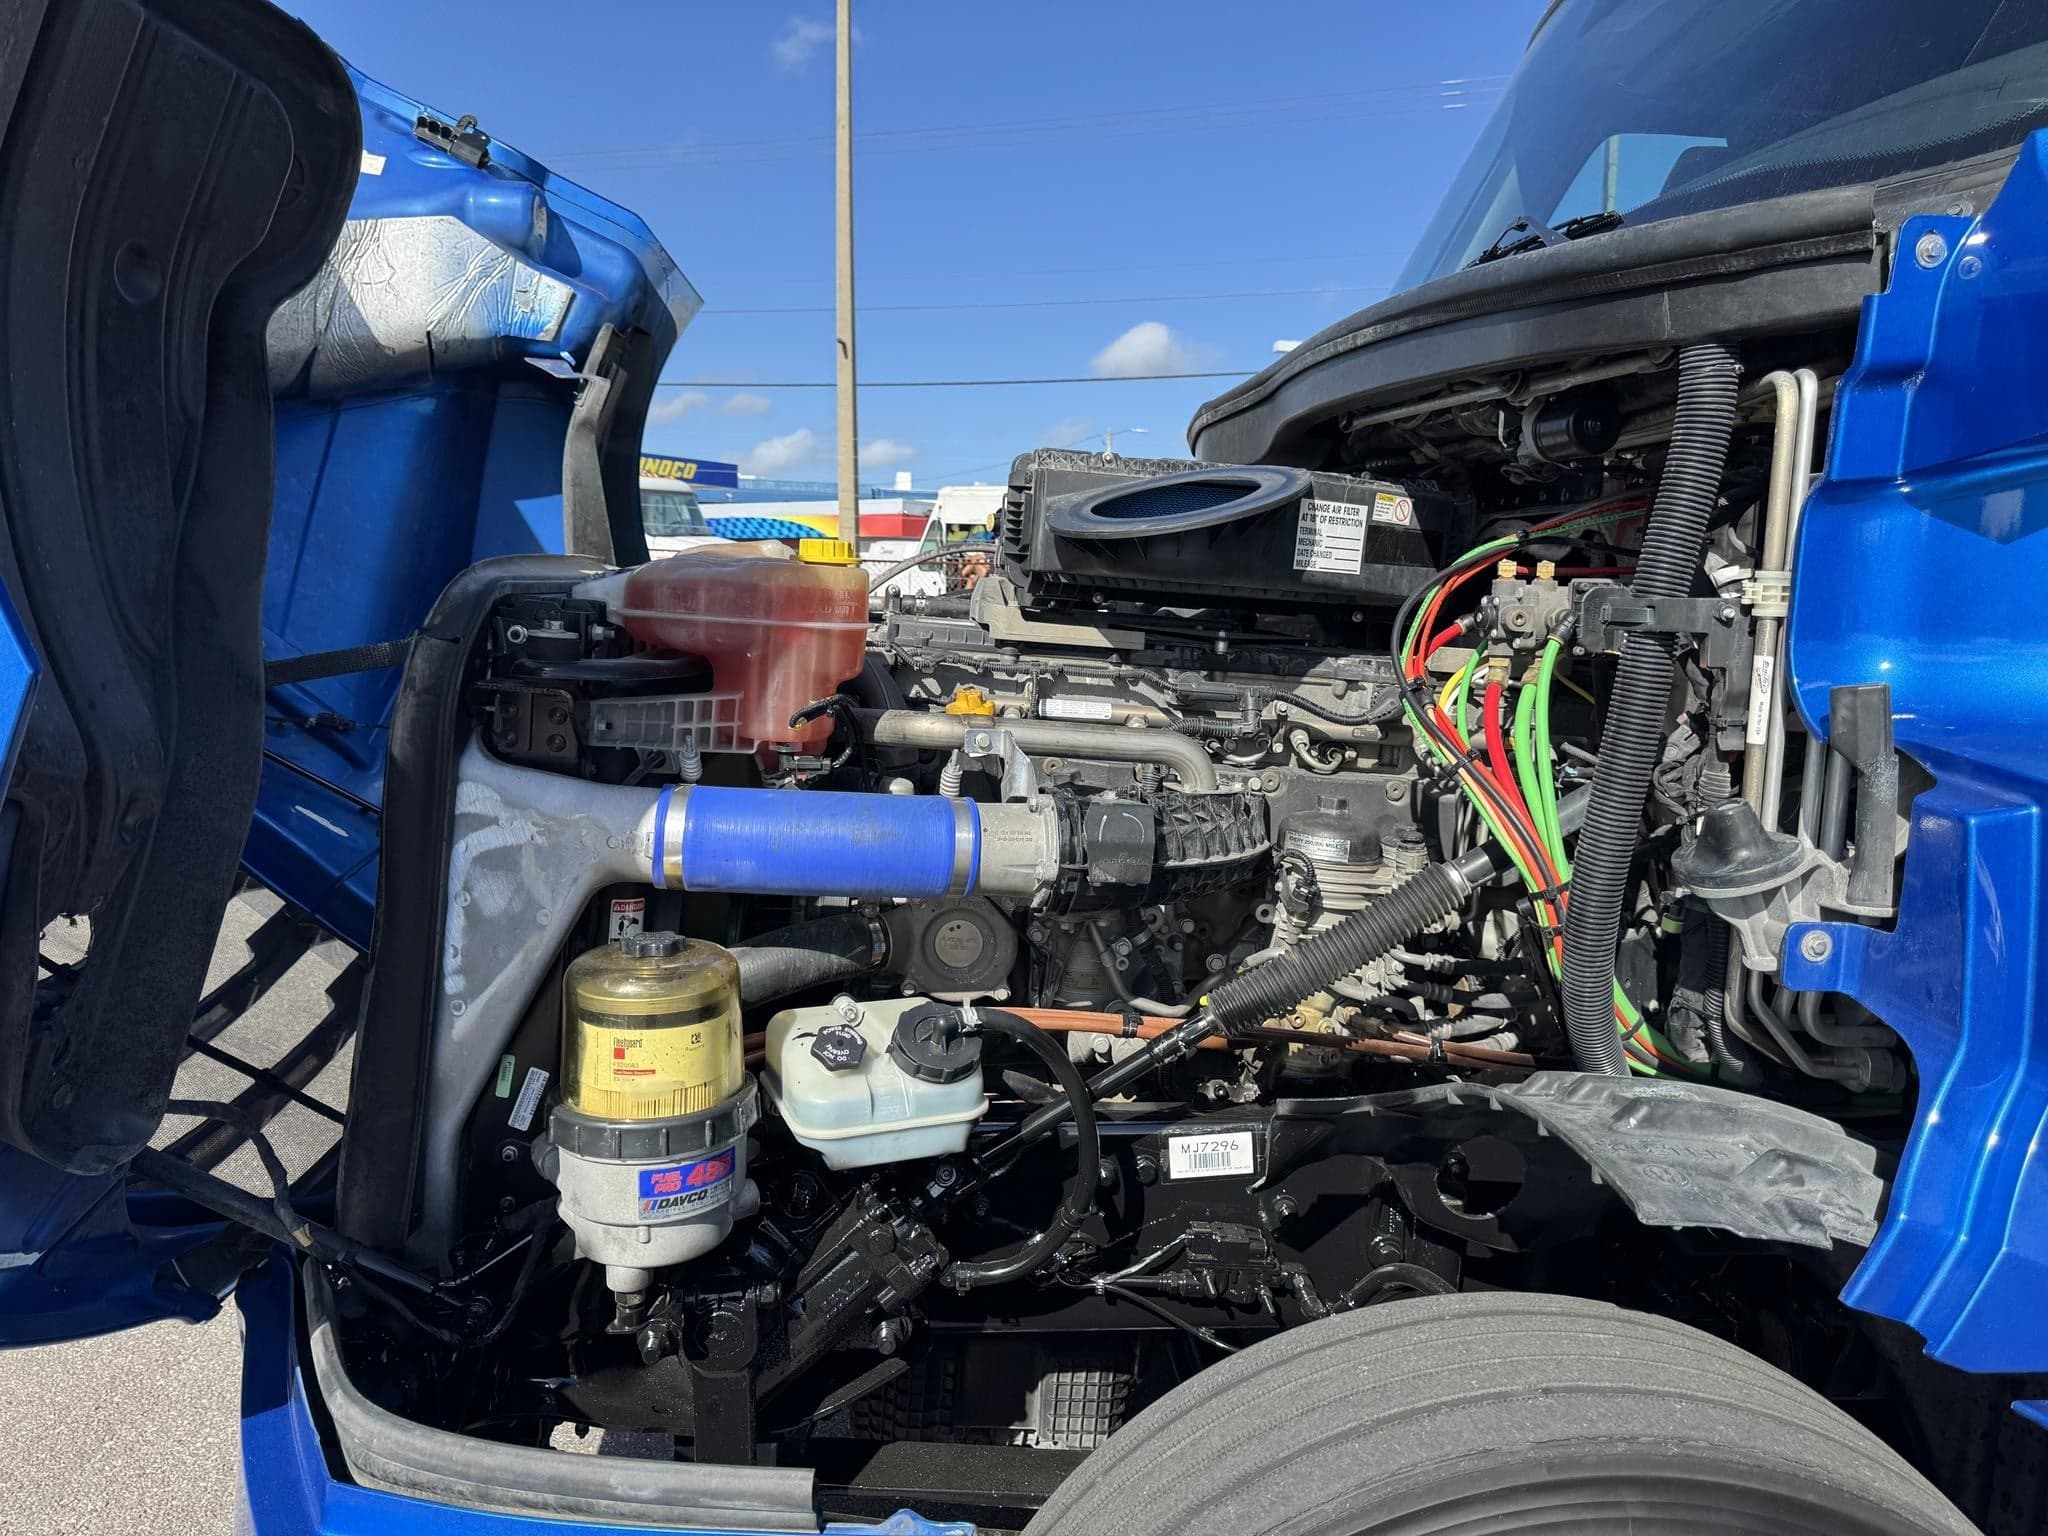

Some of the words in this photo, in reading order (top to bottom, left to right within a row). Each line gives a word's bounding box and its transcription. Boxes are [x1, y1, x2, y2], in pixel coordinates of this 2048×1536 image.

[1307, 502, 1331, 513] CHANGE
[1331, 504, 1342, 515] AIR
[1343, 506, 1361, 516] FILTER
[1301, 512, 1309, 521] AT
[1319, 515, 1328, 524] OF
[1328, 516, 1364, 528] RESTRICTION
[1299, 526, 1323, 536] TERMINAL
[1298, 537, 1323, 547] MECHANIC
[1296, 548, 1309, 557] DATE
[1310, 549, 1333, 559] CHANGED
[1295, 559, 1317, 569] MILEAGE
[835, 1031, 851, 1039] FLUID
[613, 1037, 643, 1049] Fleetguard
[1181, 1140, 1239, 1154] MJ7296
[651, 1170, 682, 1184] FUEL
[654, 1181, 681, 1194] PRO
[657, 1188, 708, 1210] DAVCO
